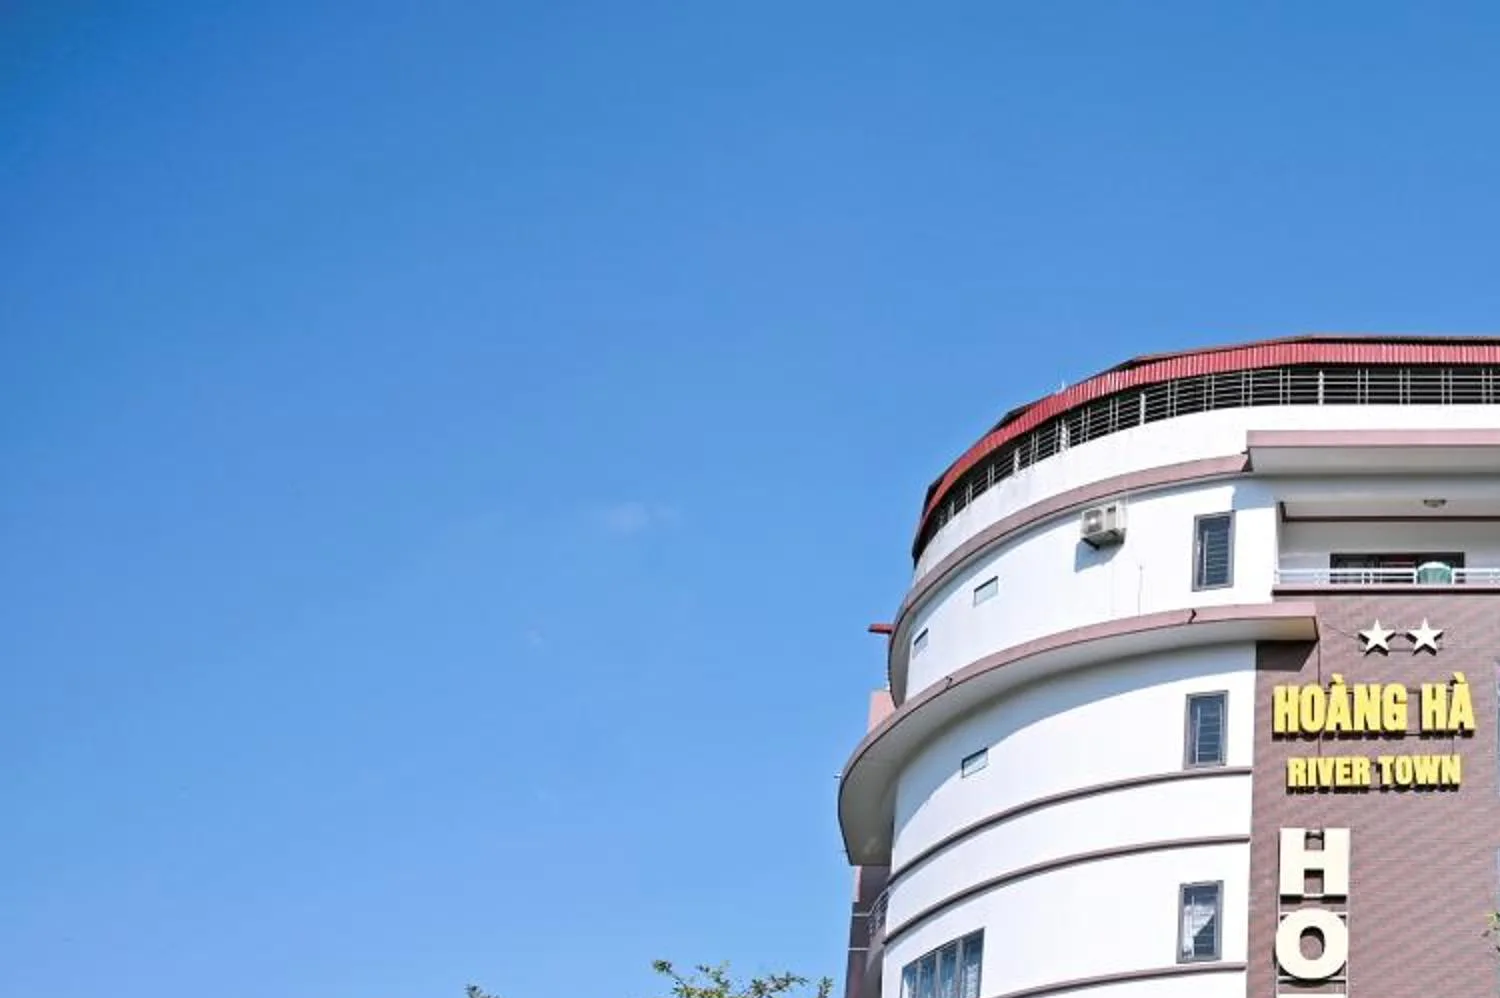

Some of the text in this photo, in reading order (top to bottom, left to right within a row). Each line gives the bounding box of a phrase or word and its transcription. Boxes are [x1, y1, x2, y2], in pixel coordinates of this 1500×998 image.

[1273, 672, 1475, 735] HOÀNG HÀ
[1287, 755, 1461, 789] RIVER TOWN
